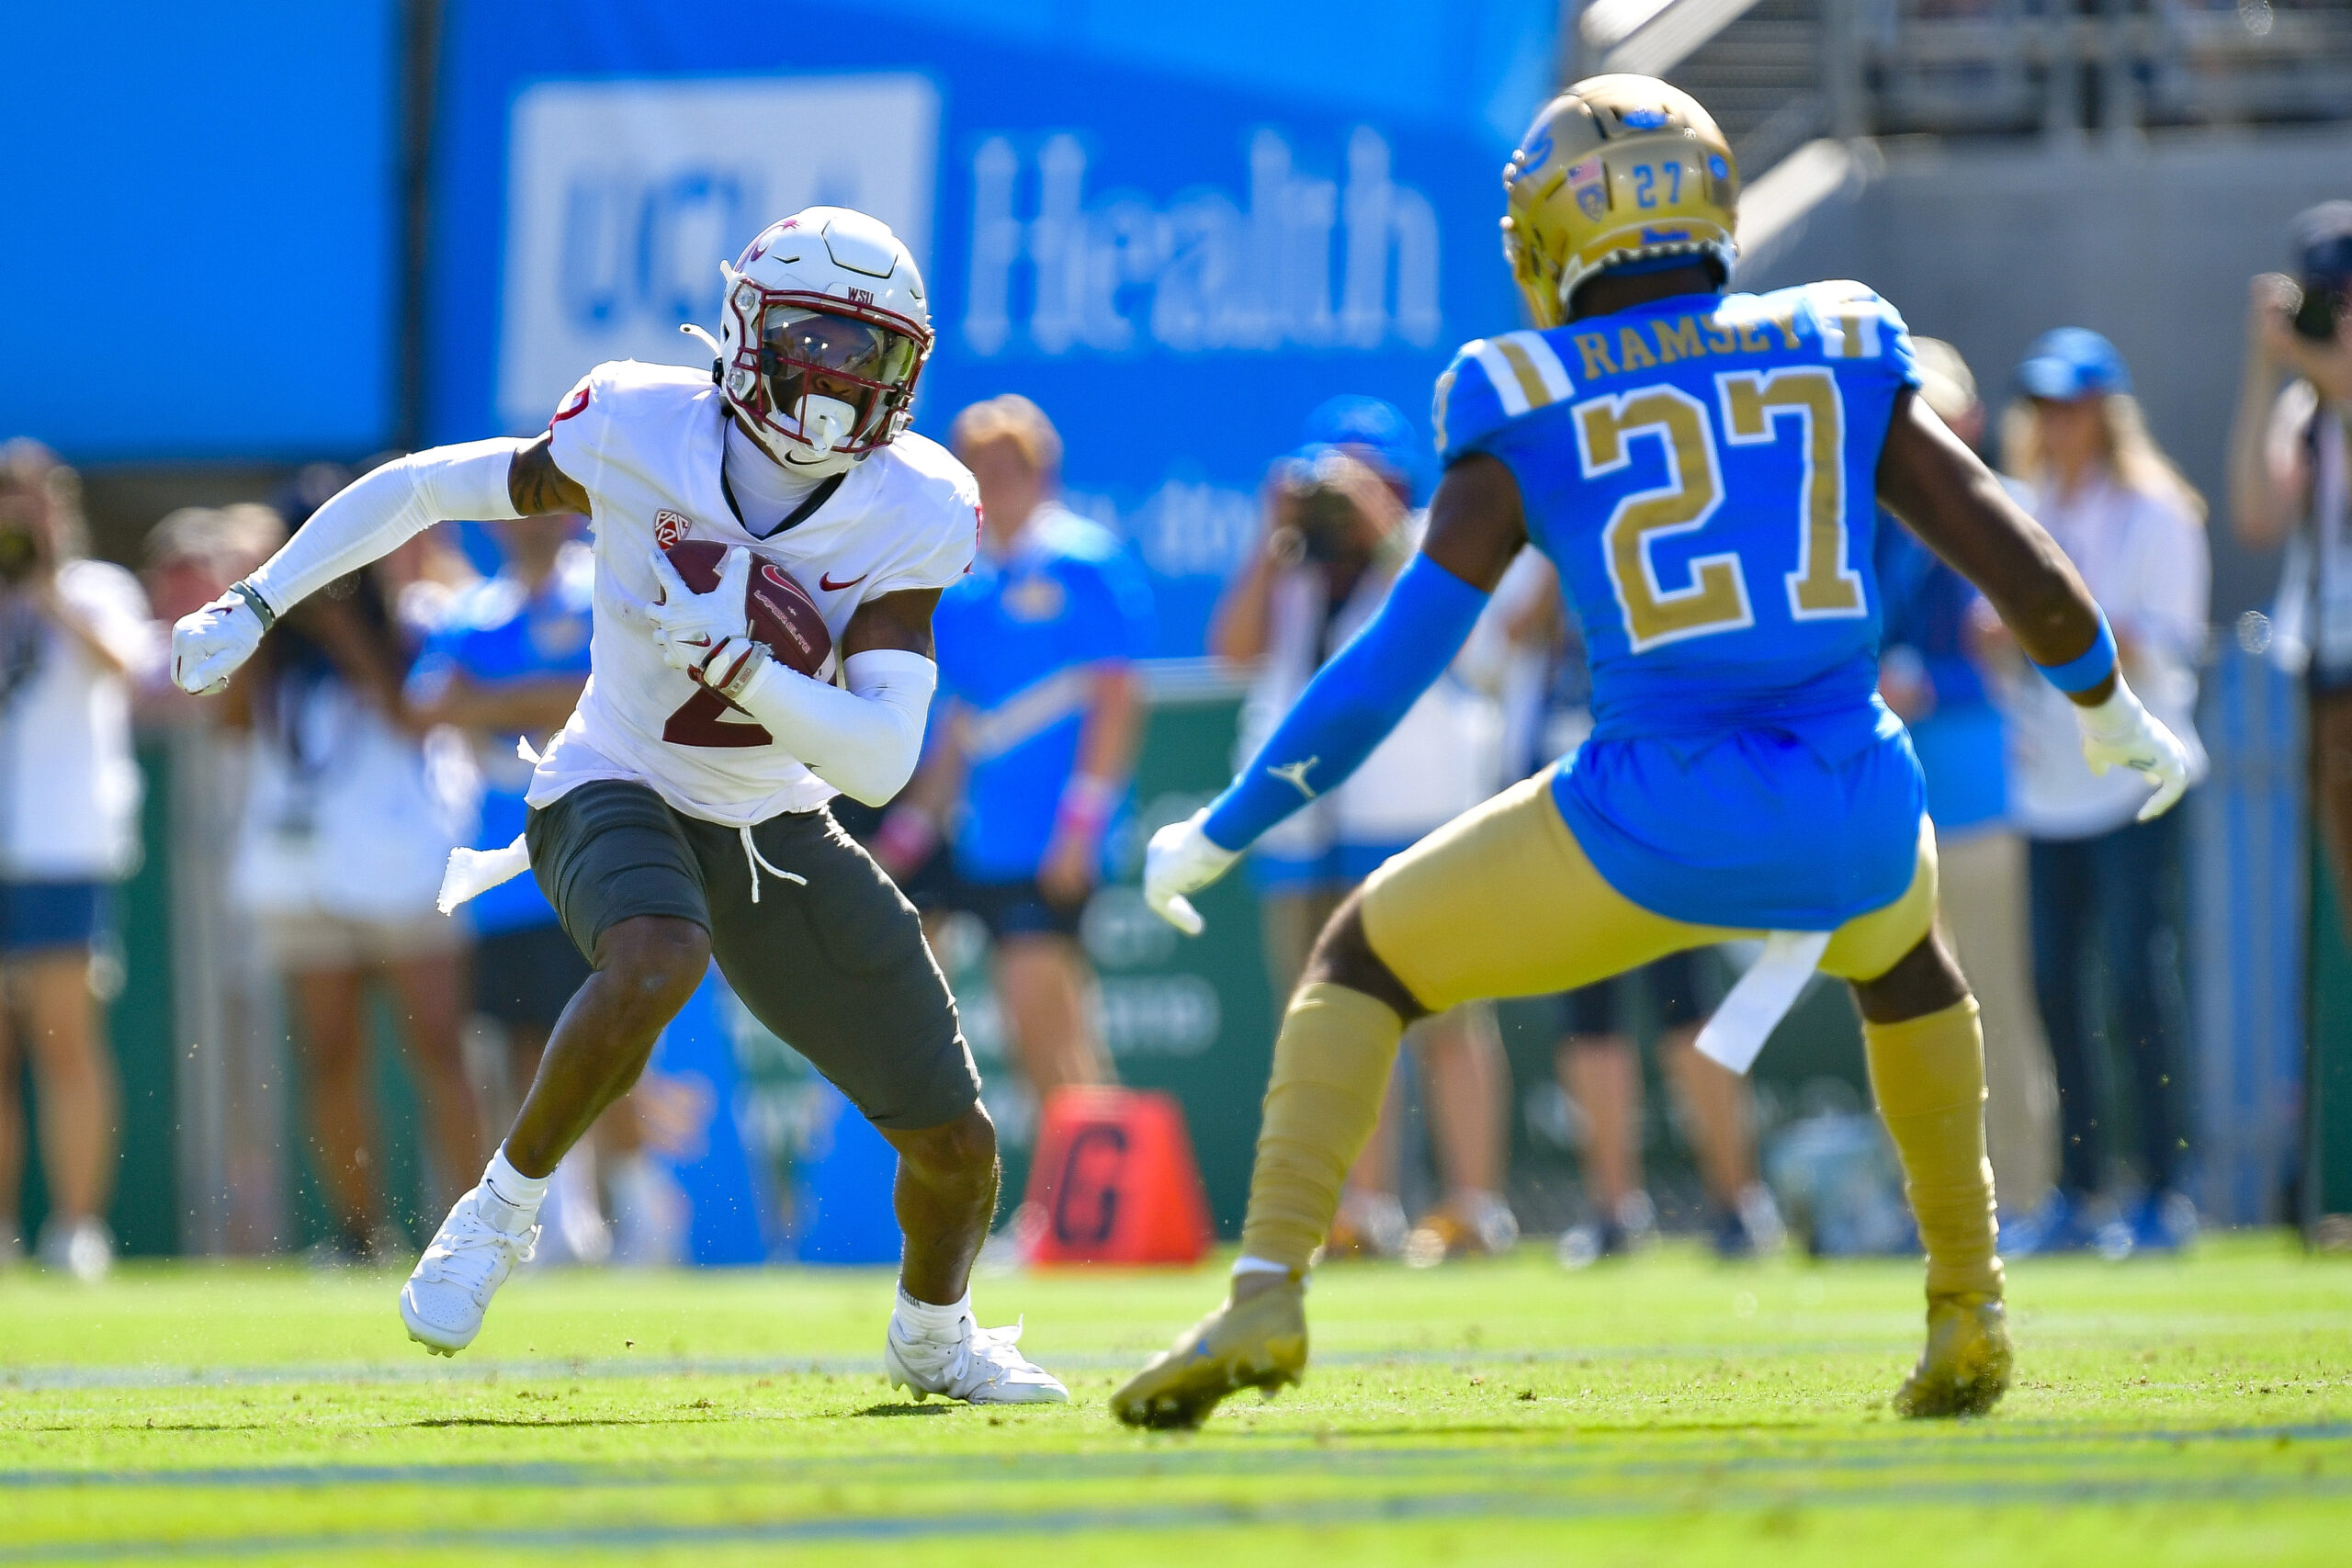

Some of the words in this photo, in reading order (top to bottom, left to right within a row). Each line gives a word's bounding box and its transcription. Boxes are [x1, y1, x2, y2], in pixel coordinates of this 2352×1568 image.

[1632, 161, 1682, 209] 27
[965, 125, 1442, 355] Health
[847, 285, 875, 305] WSU
[1572, 313, 1803, 381] RAMSEY
[655, 511, 690, 542] PAC
[657, 526, 678, 547] 12
[1570, 365, 1869, 656] 27
[753, 589, 788, 625] VAPOR
[785, 621, 811, 654] ELITE
[1054, 1122, 1129, 1247] G
